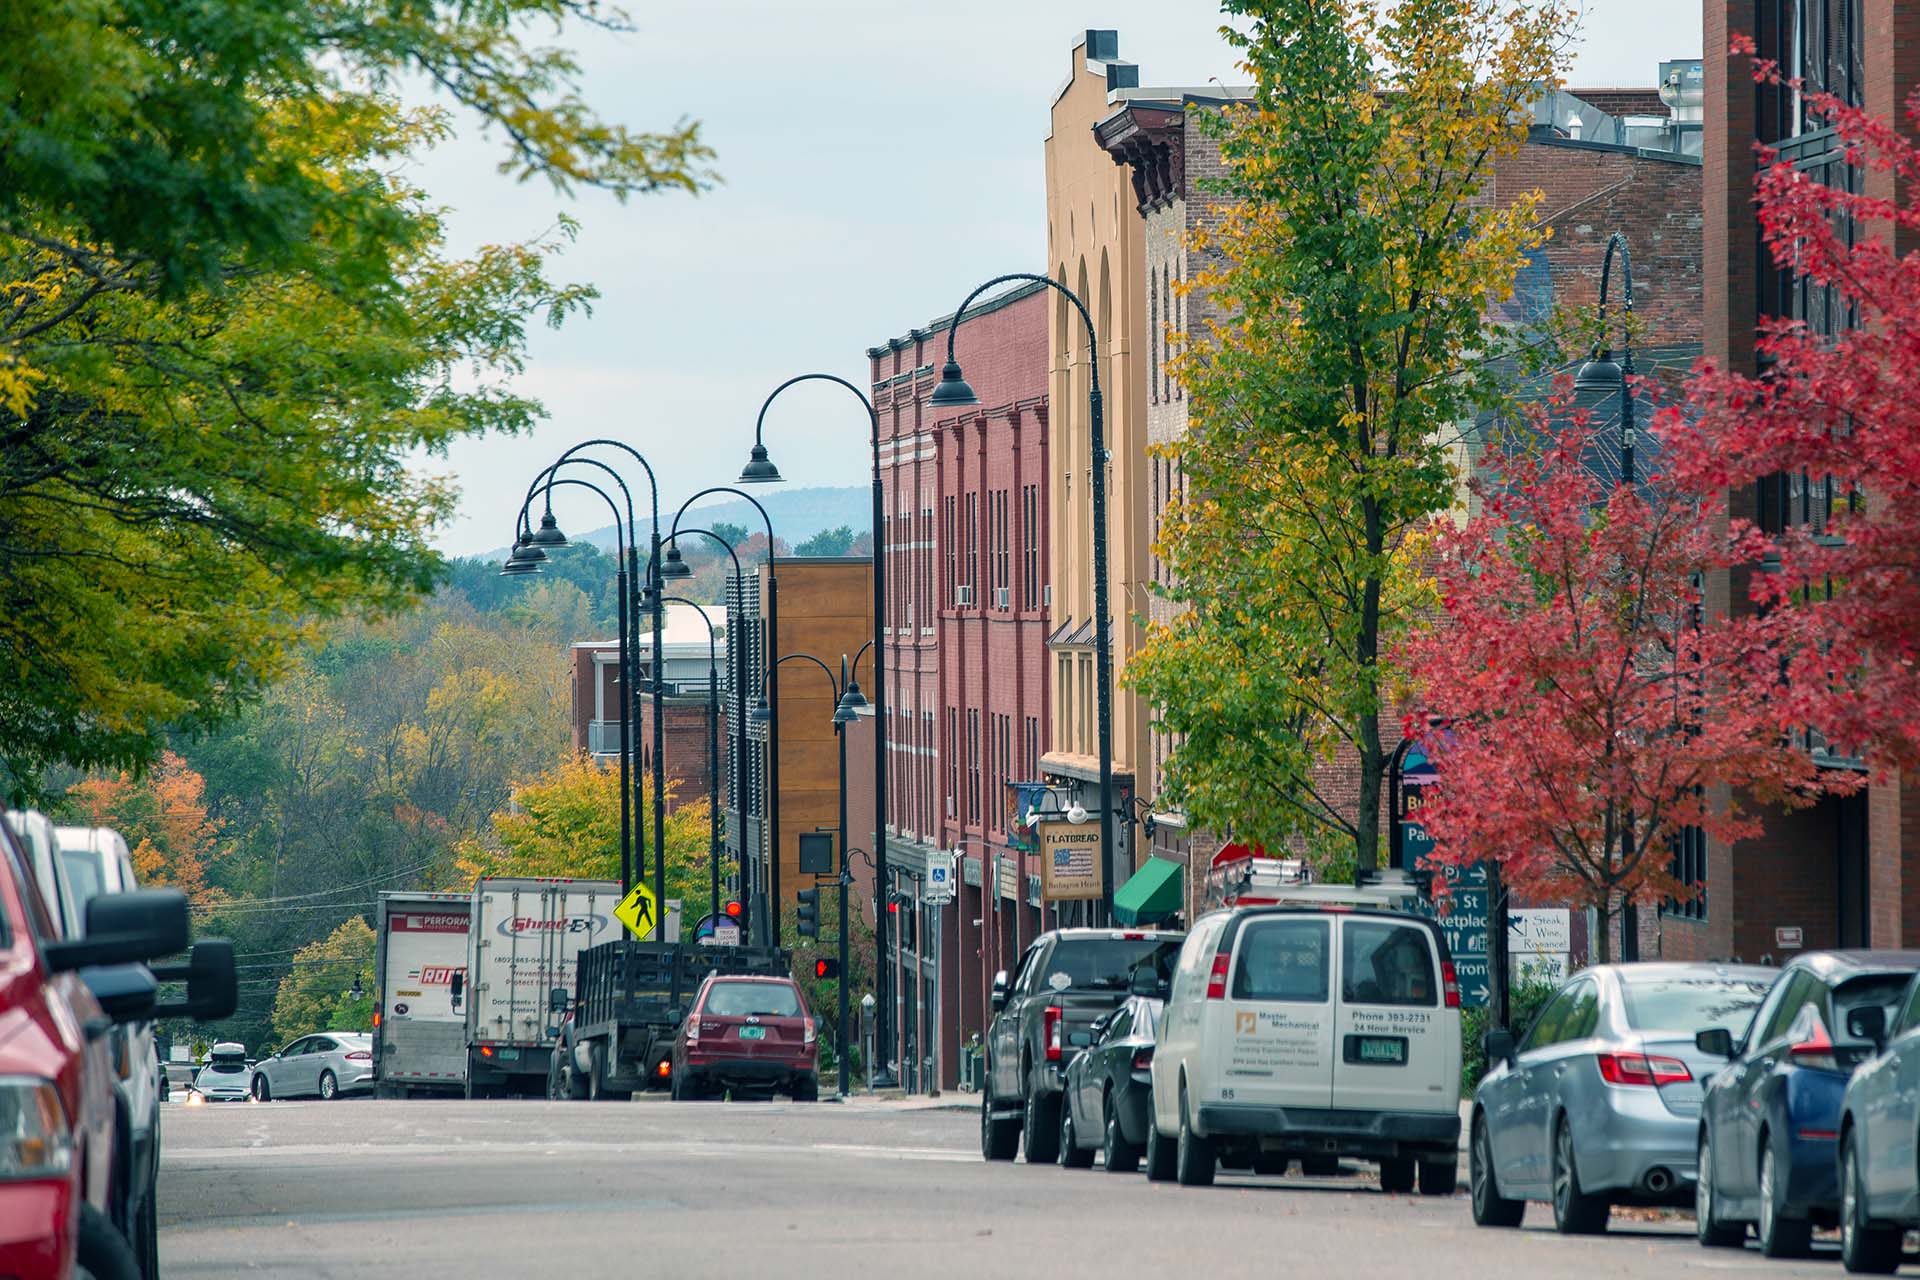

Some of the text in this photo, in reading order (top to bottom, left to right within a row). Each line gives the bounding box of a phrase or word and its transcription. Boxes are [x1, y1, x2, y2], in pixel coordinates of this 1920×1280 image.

[1046, 833, 1099, 843] FLATBREAD
[1463, 895, 1478, 908] St
[1532, 915, 1565, 925] Steak,
[511, 918, 594, 933] Shred-Ex
[1536, 927, 1562, 937] Wine,
[1259, 1011, 1287, 1020] Master
[1352, 1011, 1431, 1023] Phone 393-2731
[1272, 1022, 1319, 1030] Mechanical
[1354, 1024, 1425, 1034] 24 Hour Service
[1222, 1089, 1234, 1099] 85
